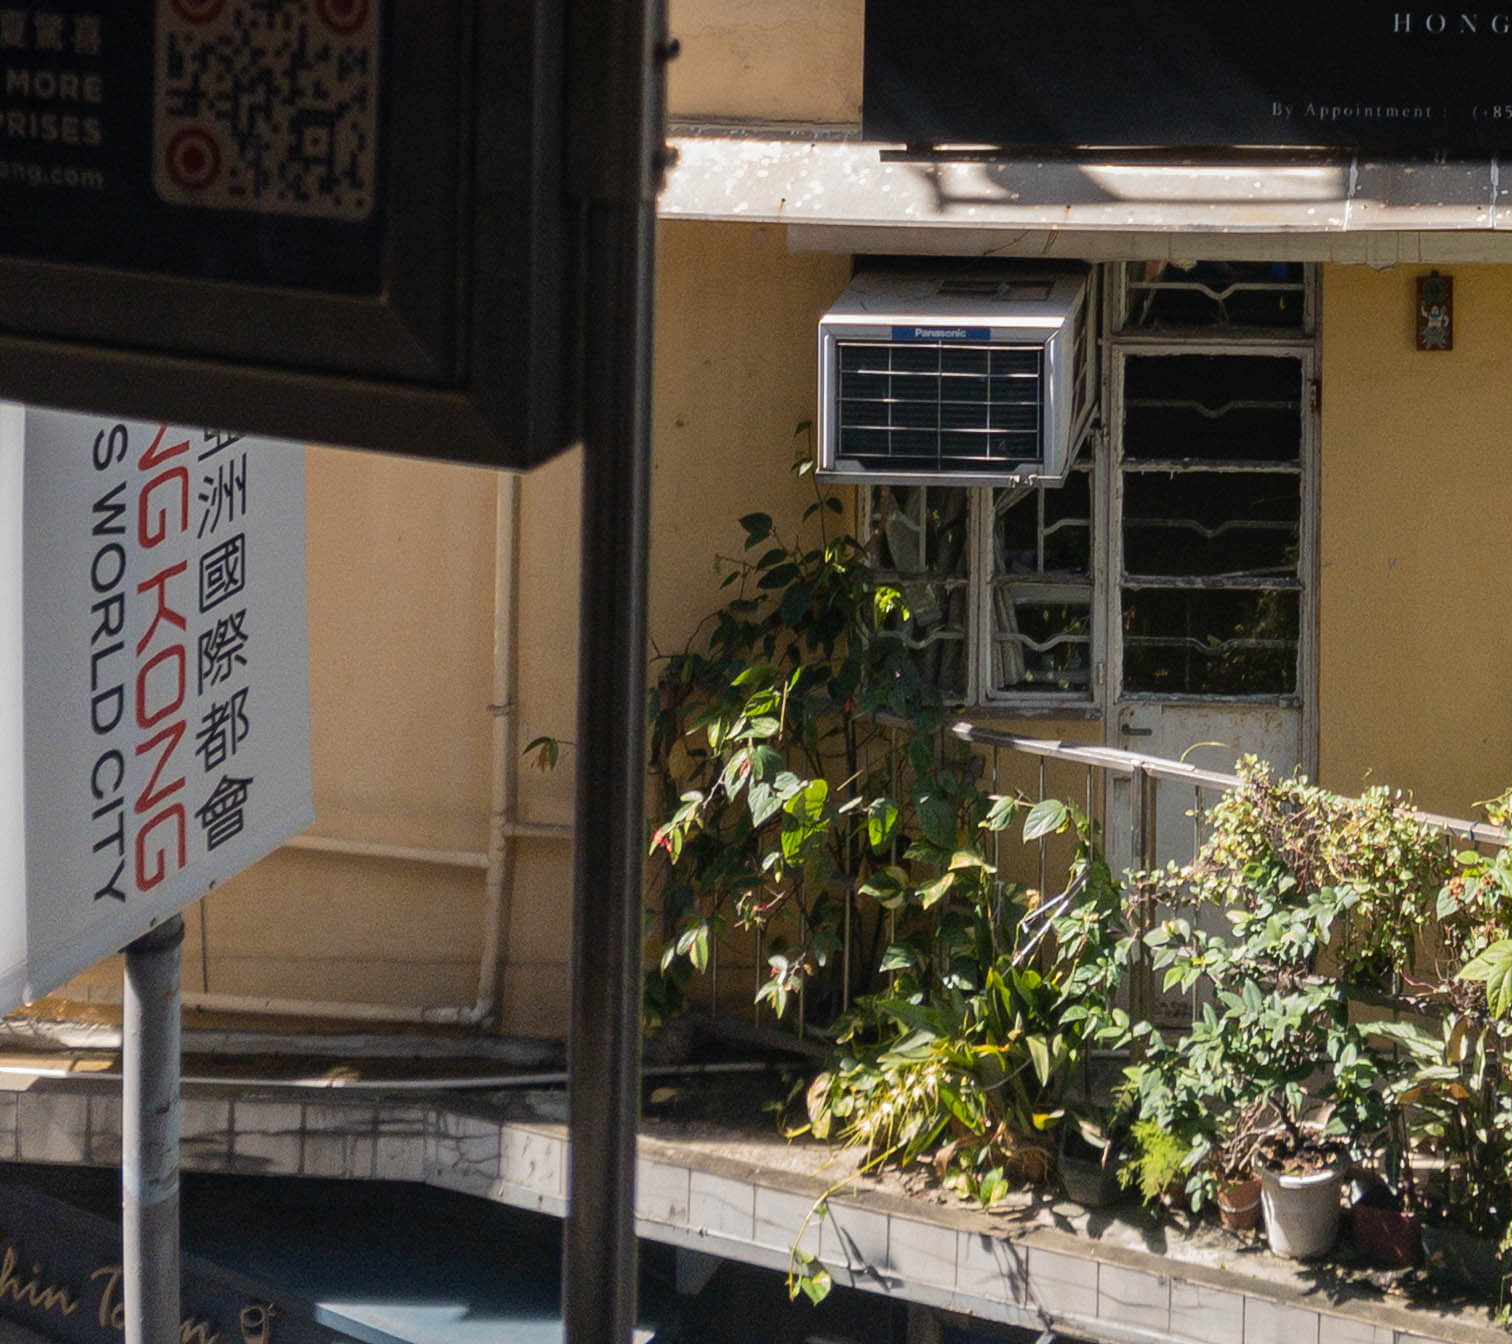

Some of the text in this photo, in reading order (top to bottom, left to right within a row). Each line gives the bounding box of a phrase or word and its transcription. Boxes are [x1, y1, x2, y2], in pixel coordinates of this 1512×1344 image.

[1393, 11, 1510, 33] HONG
[7, 68, 103, 104] MORE
[1271, 101, 1292, 120] By
[1304, 103, 1431, 121] Appointment
[90, 480, 127, 736] WORLD
[134, 560, 188, 892] KONG
[90, 749, 127, 903] CITY
